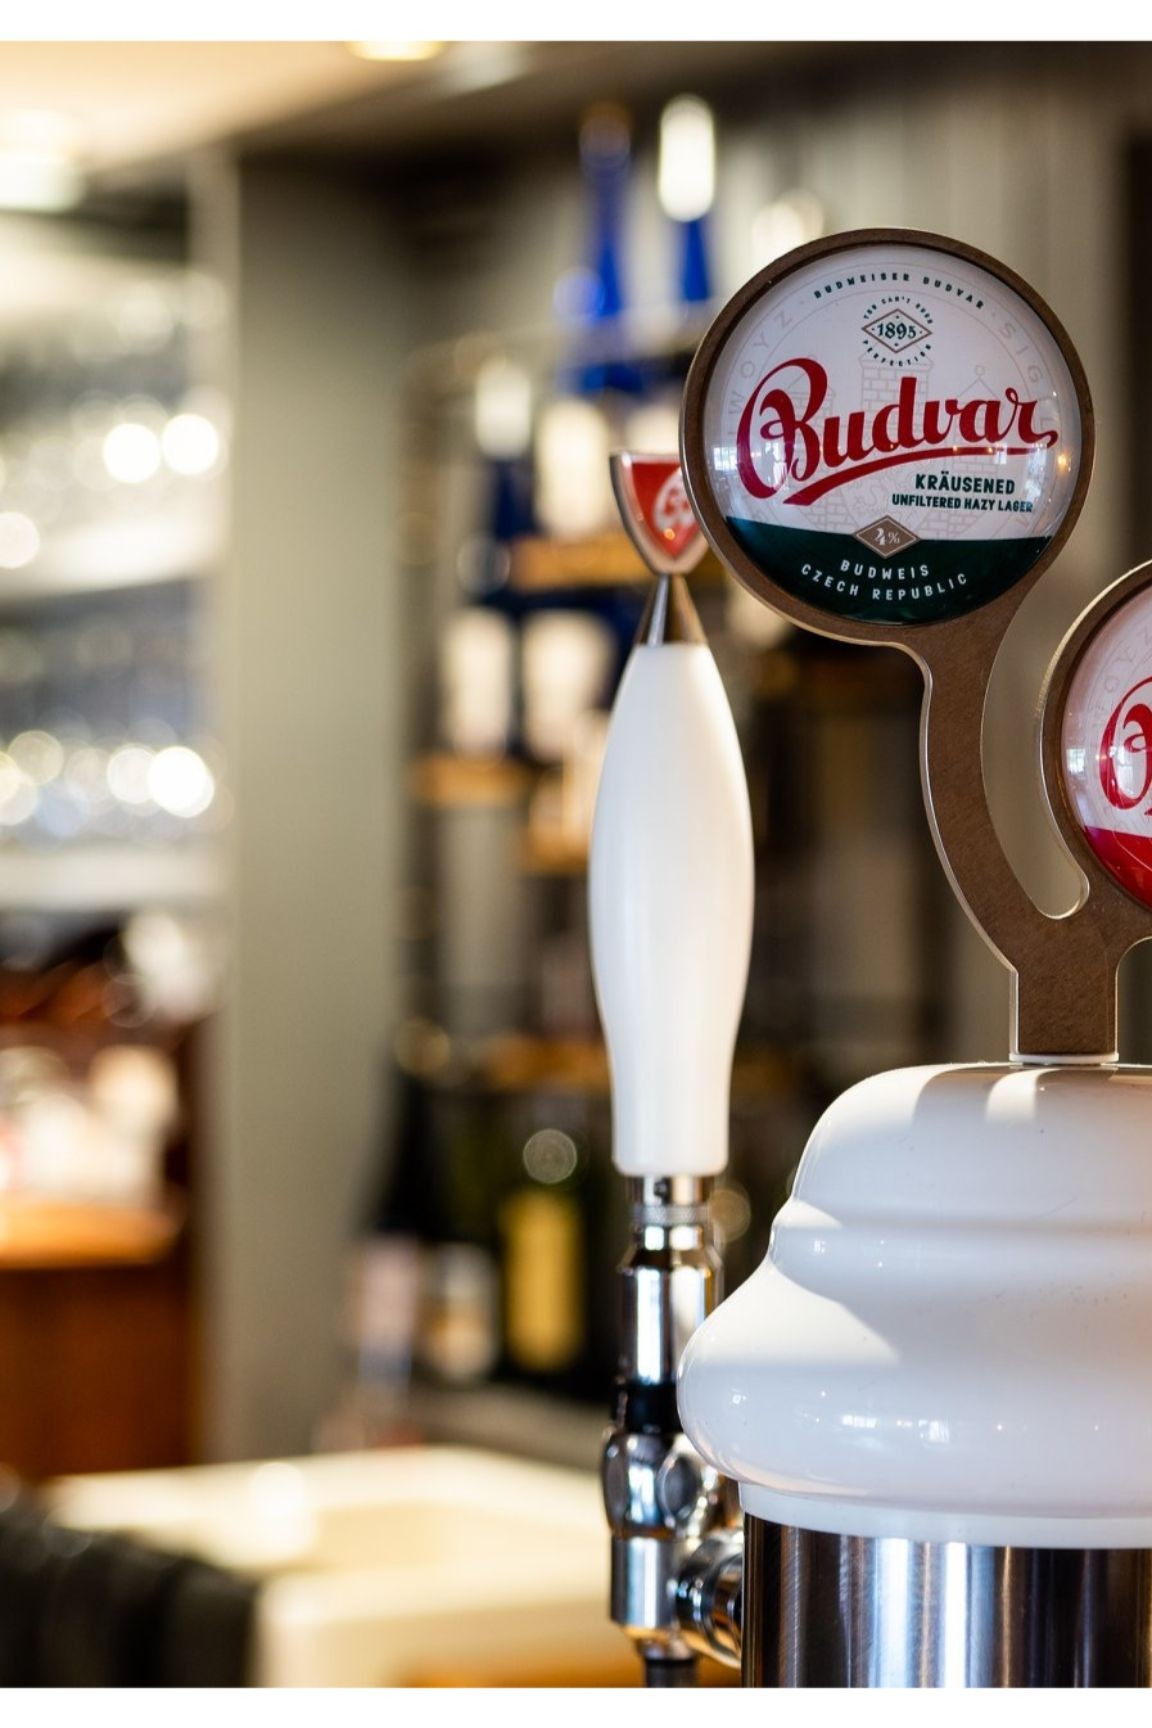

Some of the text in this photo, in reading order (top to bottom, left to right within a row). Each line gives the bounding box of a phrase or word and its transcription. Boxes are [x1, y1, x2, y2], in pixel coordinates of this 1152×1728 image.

[814, 273, 984, 310] BUDWEISER BUDVAR
[877, 322, 917, 340] 1895
[737, 357, 1059, 500] Budvar
[915, 470, 1015, 495] KRÄUSENED
[892, 493, 1034, 513] UNFILTERED HAZY LAGER
[801, 563, 967, 601] CZECH REPUBLIC
[840, 559, 930, 580] BUDWEIS
